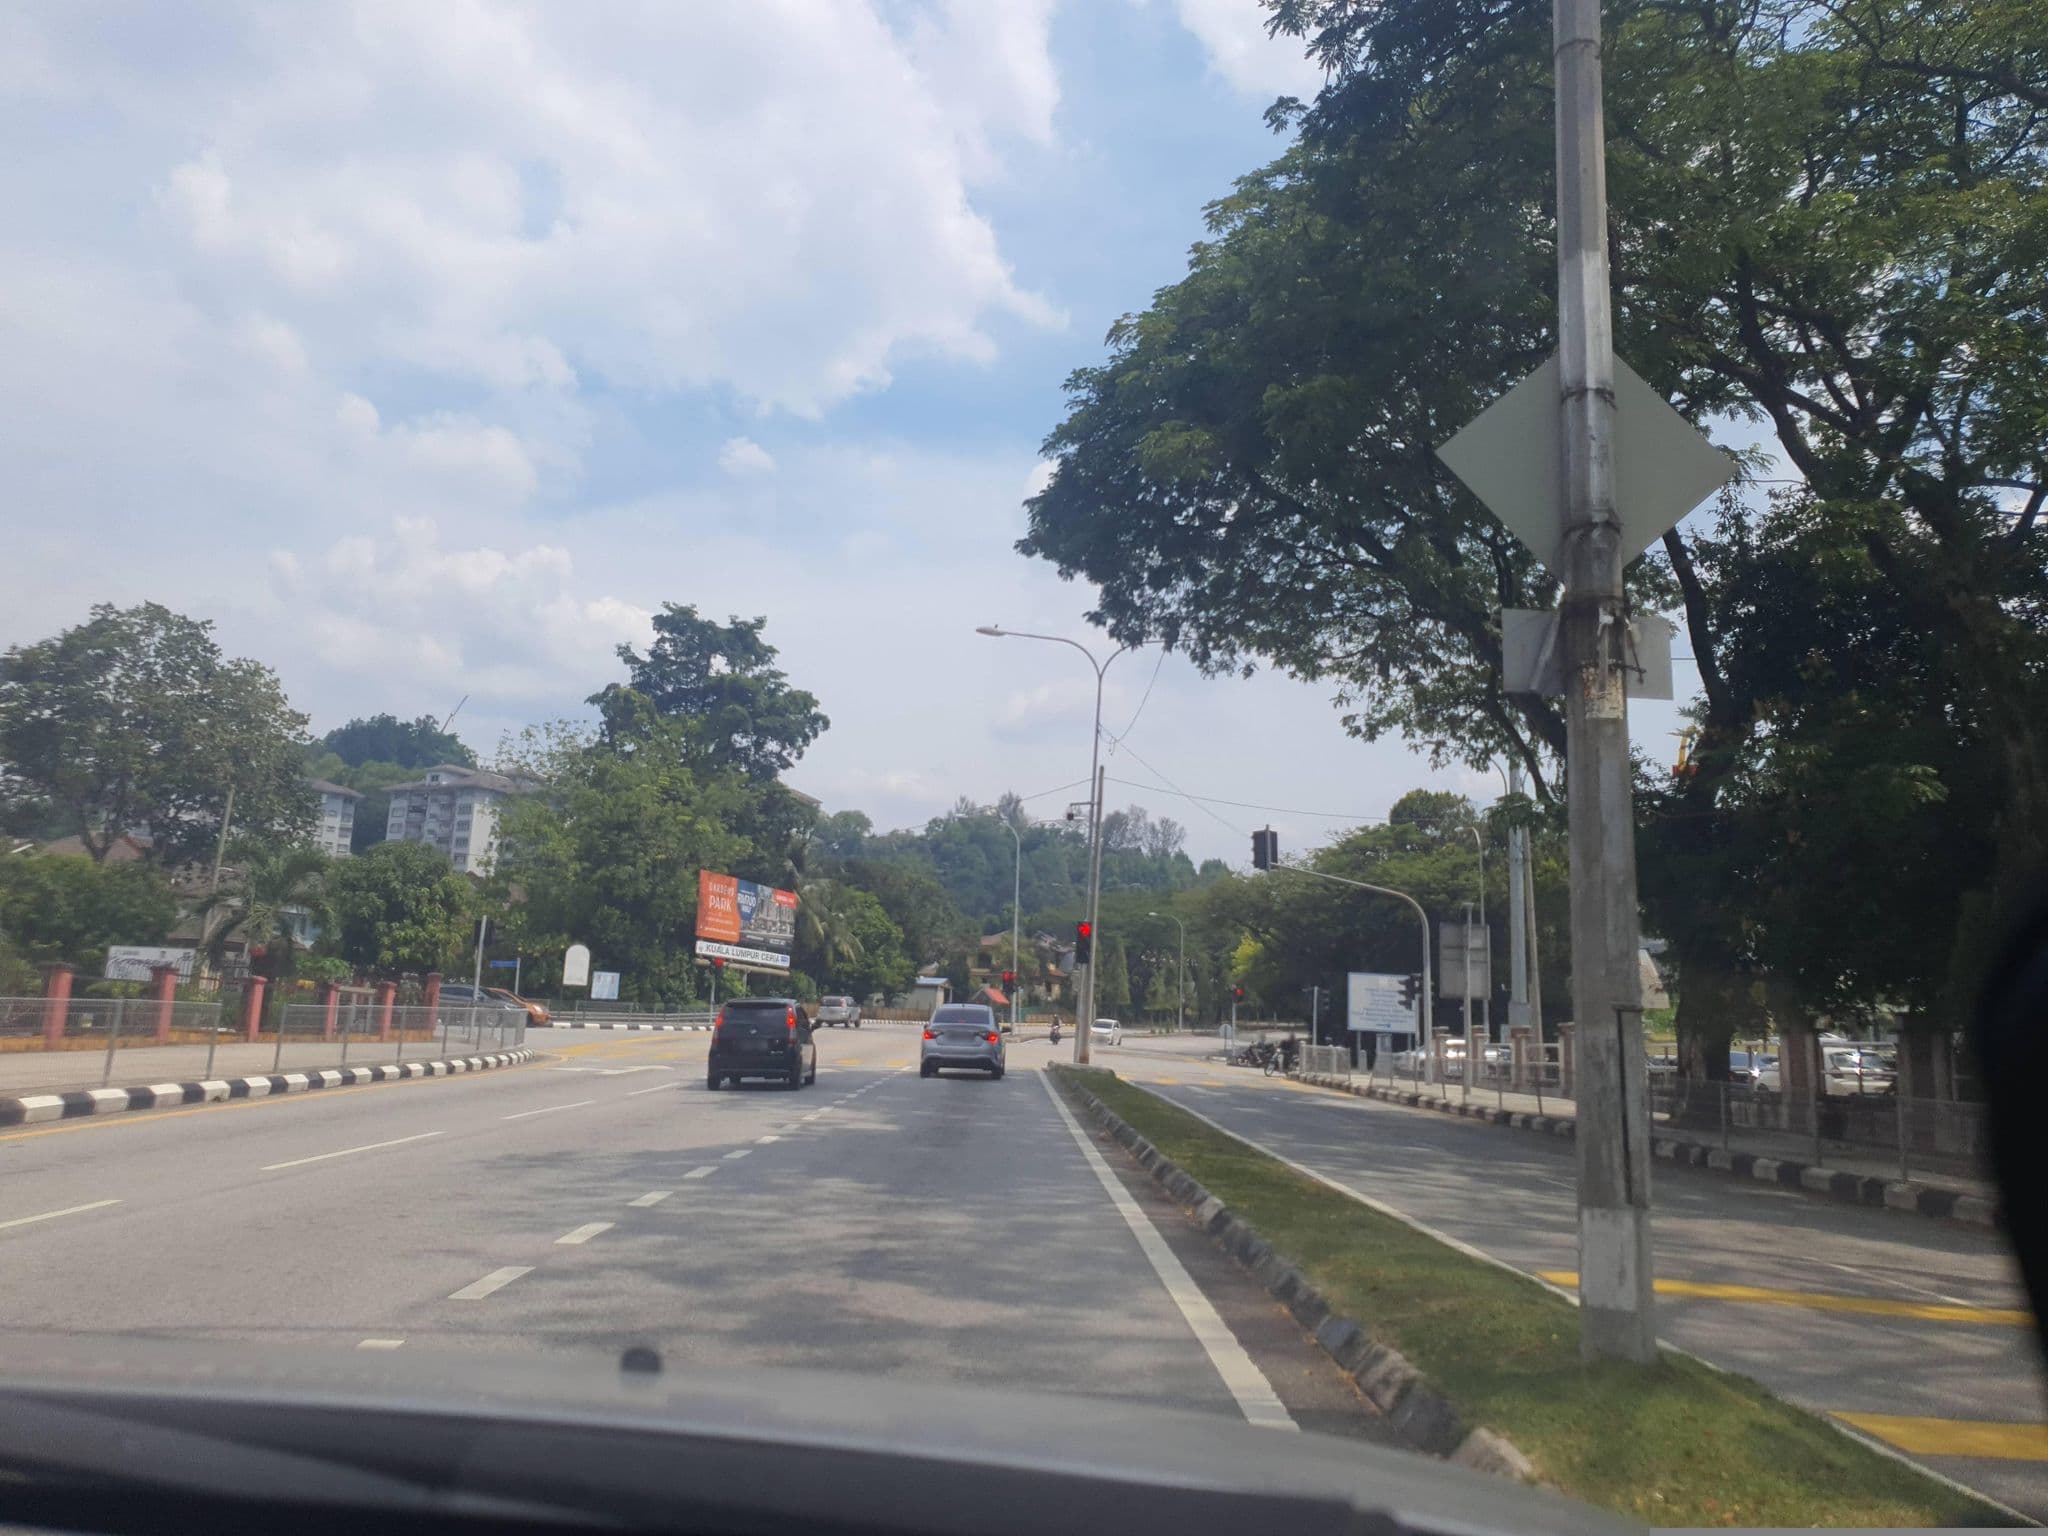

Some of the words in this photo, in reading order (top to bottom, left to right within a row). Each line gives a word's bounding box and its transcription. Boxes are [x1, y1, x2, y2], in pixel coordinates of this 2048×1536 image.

[709, 896, 732, 912] PARK
[706, 944, 729, 955] KUALA
[732, 948, 760, 959] LUMPUR
